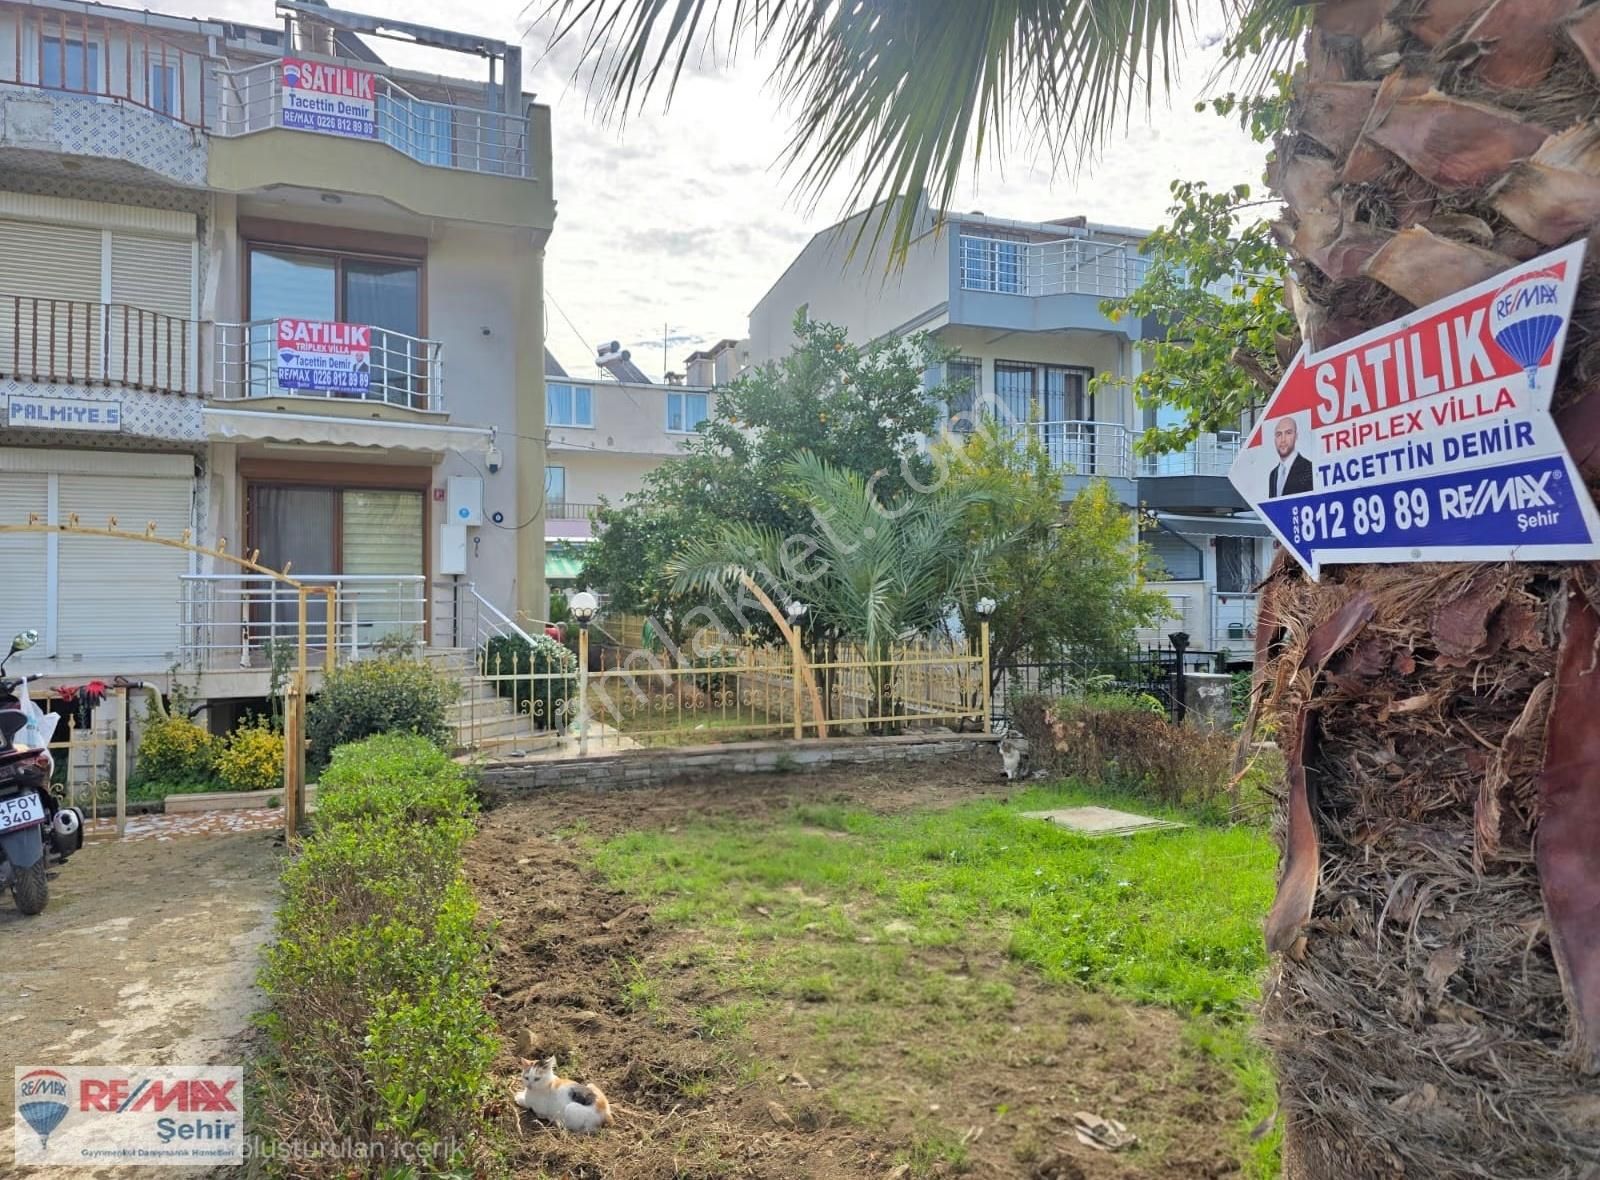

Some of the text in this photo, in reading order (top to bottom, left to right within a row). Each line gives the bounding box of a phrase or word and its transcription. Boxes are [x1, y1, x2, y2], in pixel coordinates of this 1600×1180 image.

[301, 63, 372, 98] SATILIK
[289, 94, 369, 118] Tacettin Demir
[284, 111, 314, 125] RE/MAX
[317, 116, 335, 128] 0226
[337, 119, 351, 130] 812
[352, 121, 361, 132] 89
[363, 122, 373, 134] 89
[1497, 284, 1558, 320] RE/MAX
[280, 320, 367, 346] SATILIK
[296, 342, 349, 354] TRİPLEX VİLLA
[296, 355, 351, 369] Tacettin Demir
[1315, 308, 1496, 425] SATILIK
[279, 368, 369, 388] RE/MAX 0226 812 89 89
[1321, 387, 1516, 453] TRİPLEX VİLLA
[1318, 418, 1536, 487] TACETTİN DEMİR
[1301, 471, 1556, 542] 812 89 89 RE/MAX
[1292, 506, 1300, 544] 0226
[1517, 510, 1559, 533] Şehir
[6, 795, 37, 813] FOY
[2, 810, 31, 826] 340
